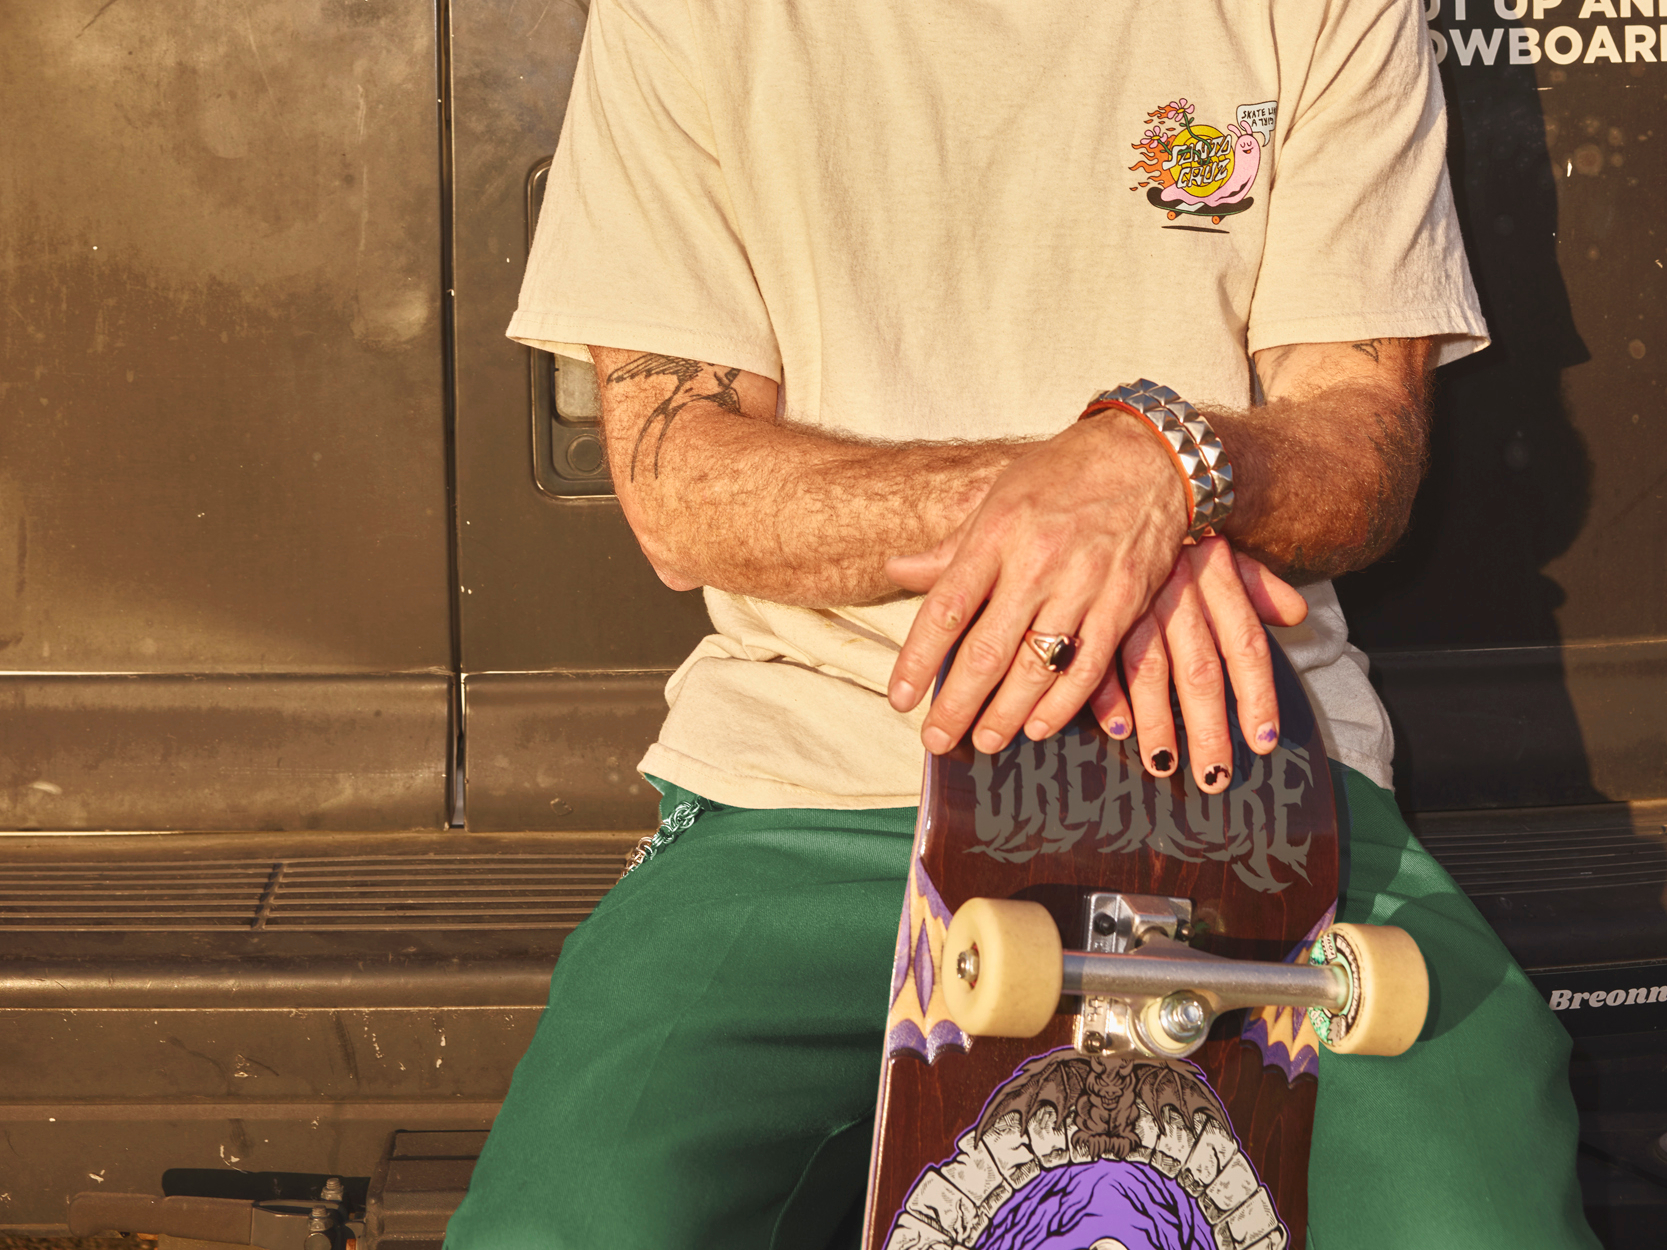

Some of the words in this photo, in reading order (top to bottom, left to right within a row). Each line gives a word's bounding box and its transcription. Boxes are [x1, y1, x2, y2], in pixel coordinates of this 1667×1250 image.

[1429, 25, 1667, 66] WBOAR
[1241, 108, 1266, 120] SKATE
[1162, 134, 1233, 171] SANTA
[1176, 158, 1231, 189] CRUZ
[1549, 985, 1667, 1011] Breonn
